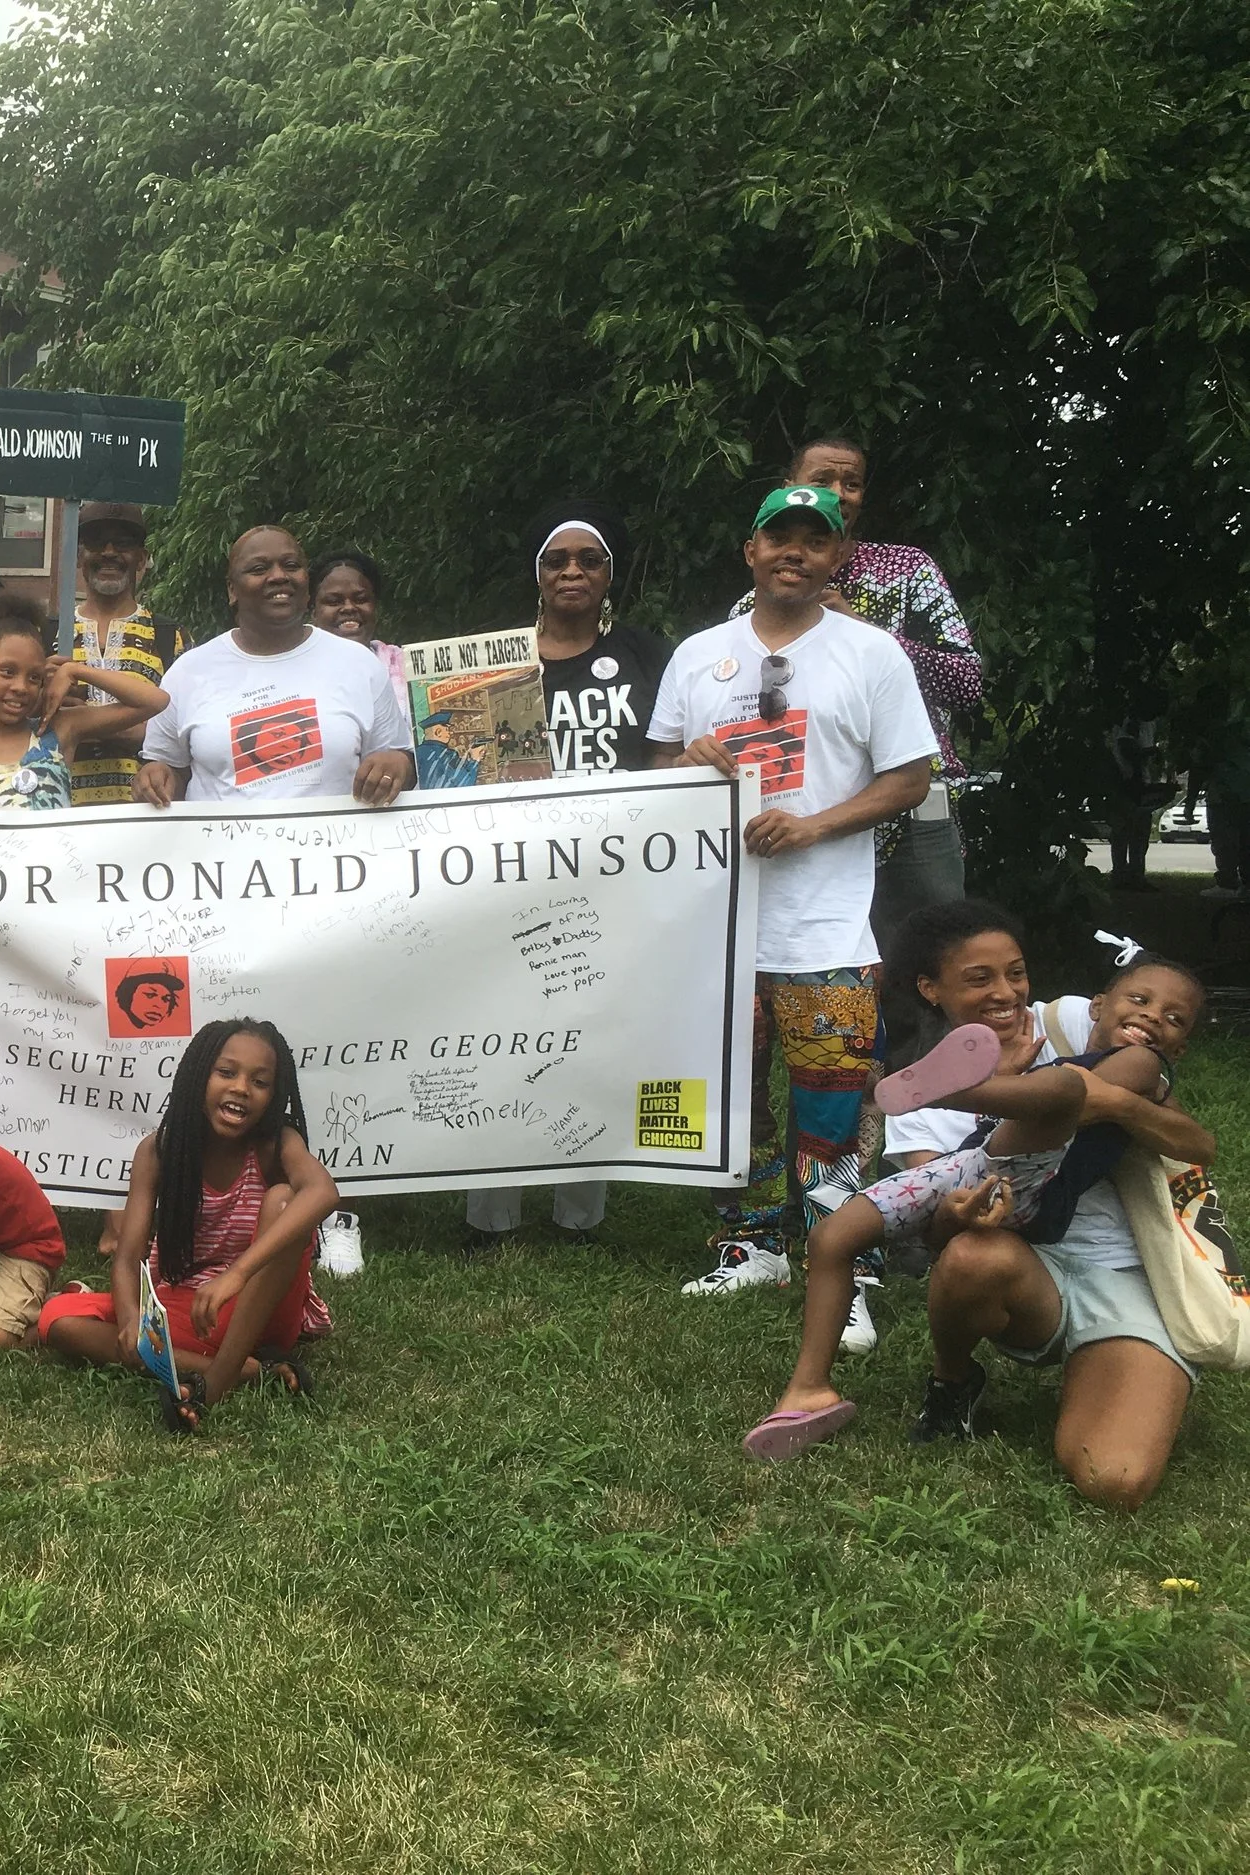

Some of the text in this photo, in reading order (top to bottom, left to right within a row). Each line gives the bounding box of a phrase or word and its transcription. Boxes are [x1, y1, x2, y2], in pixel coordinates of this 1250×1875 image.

[22, 429, 83, 459] JOHNSON
[90, 432, 113, 445] THE
[117, 435, 129, 446] III
[138, 438, 159, 468] PK
[410, 635, 530, 675] WE ARE NOT TARGETS!
[241, 684, 276, 699] JUSTICE
[549, 684, 638, 730] ACK
[731, 693, 760, 702] JUSTI
[711, 715, 747, 729] RONALD
[549, 728, 618, 771] VES
[96, 854, 367, 903] RONALD
[409, 828, 731, 898] JOHNSON
[290, 1039, 409, 1068] FICER
[430, 1029, 582, 1058] GEORGE
[58, 1083, 172, 1114] HERNA
[641, 1081, 681, 1095] BLACK
[642, 1098, 678, 1112] LIVES
[639, 1115, 689, 1129] MATTER
[641, 1131, 701, 1148] CHICAGO
[13, 1150, 132, 1182] USTICE
